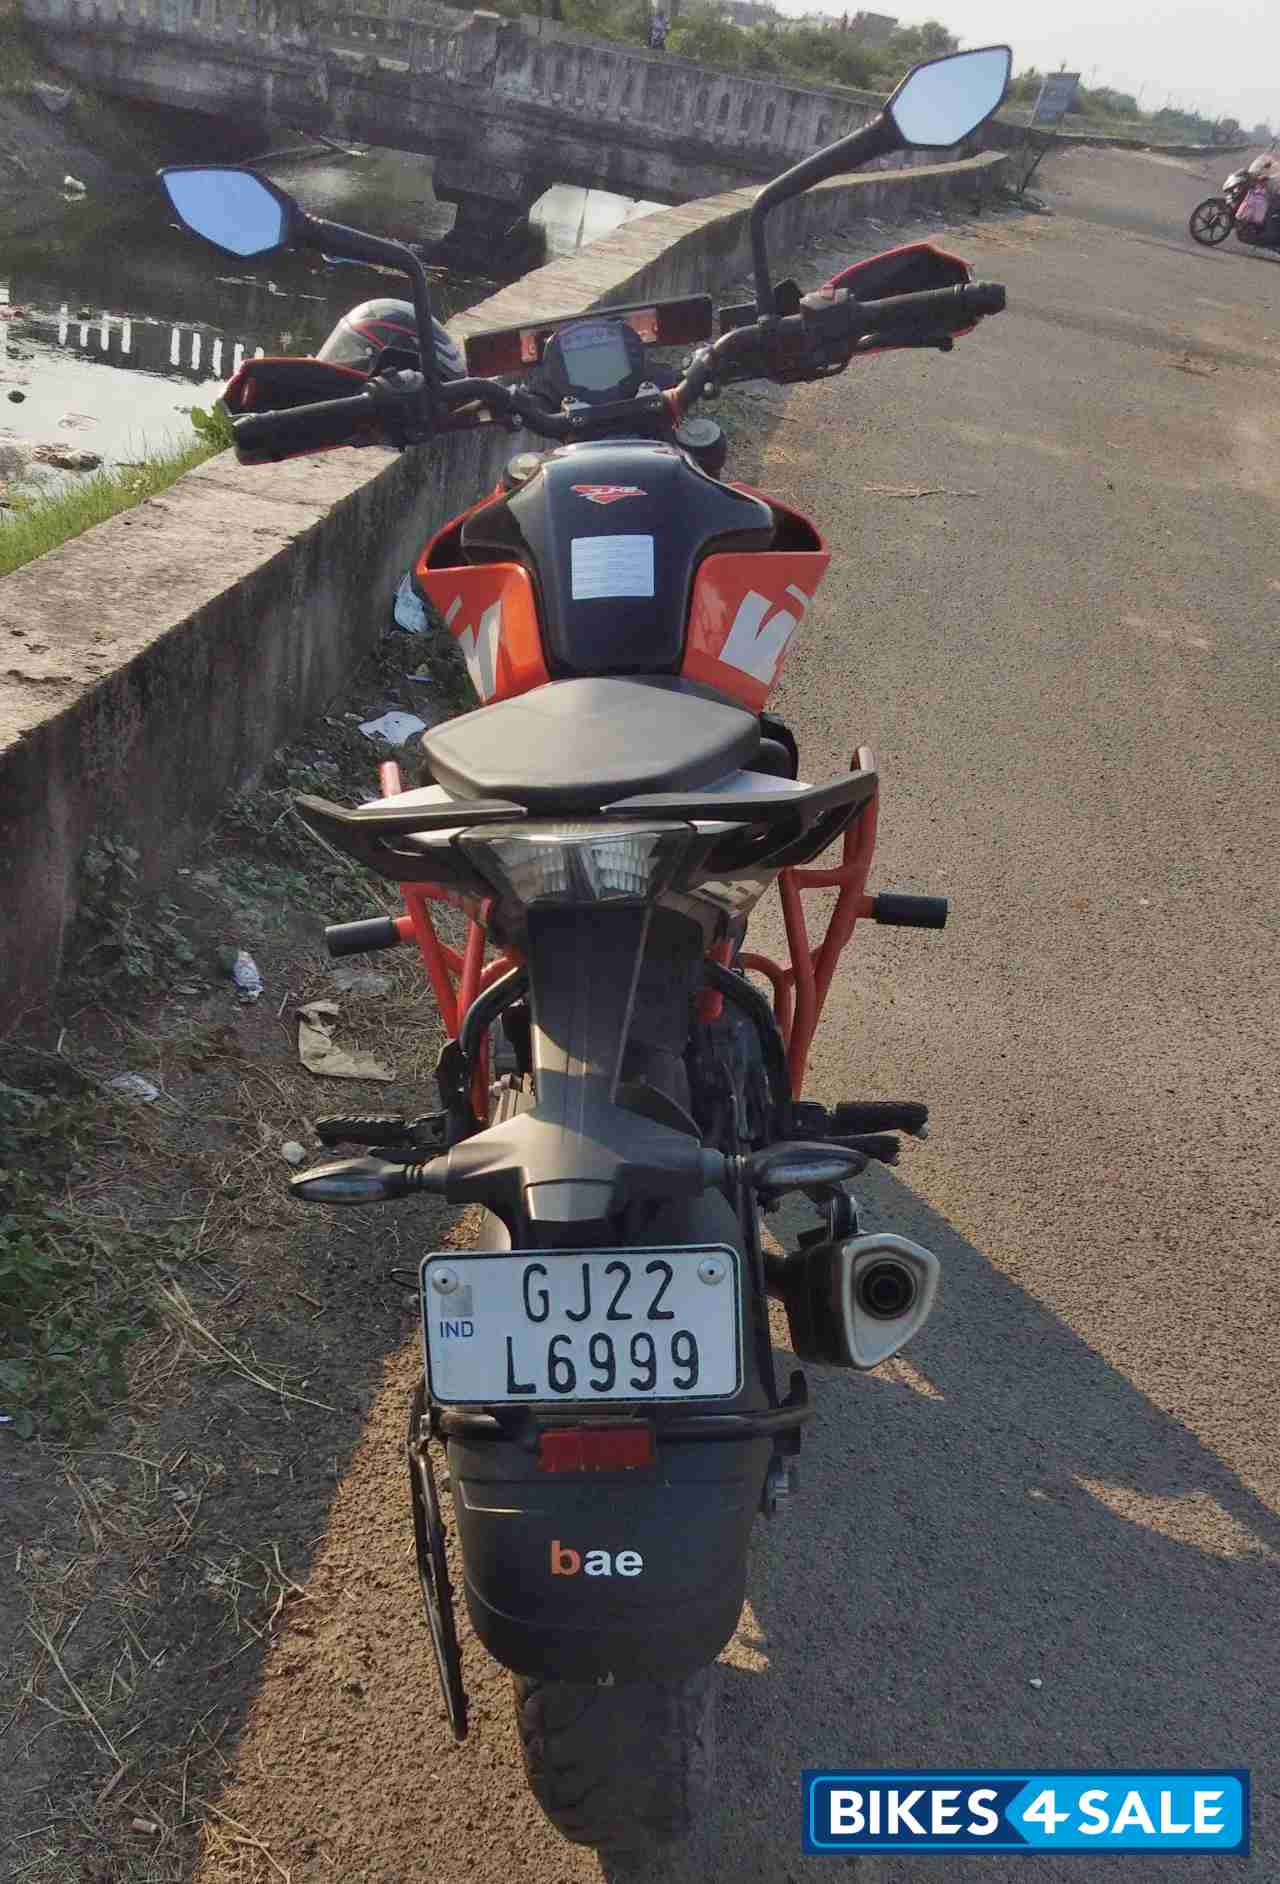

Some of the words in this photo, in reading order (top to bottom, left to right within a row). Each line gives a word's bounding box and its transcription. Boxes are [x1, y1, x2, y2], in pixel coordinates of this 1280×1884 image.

[523, 1260, 675, 1323] GJ22
[440, 1320, 474, 1339] IND
[506, 1330, 700, 1394] L6999
[551, 1540, 643, 1576] bae
